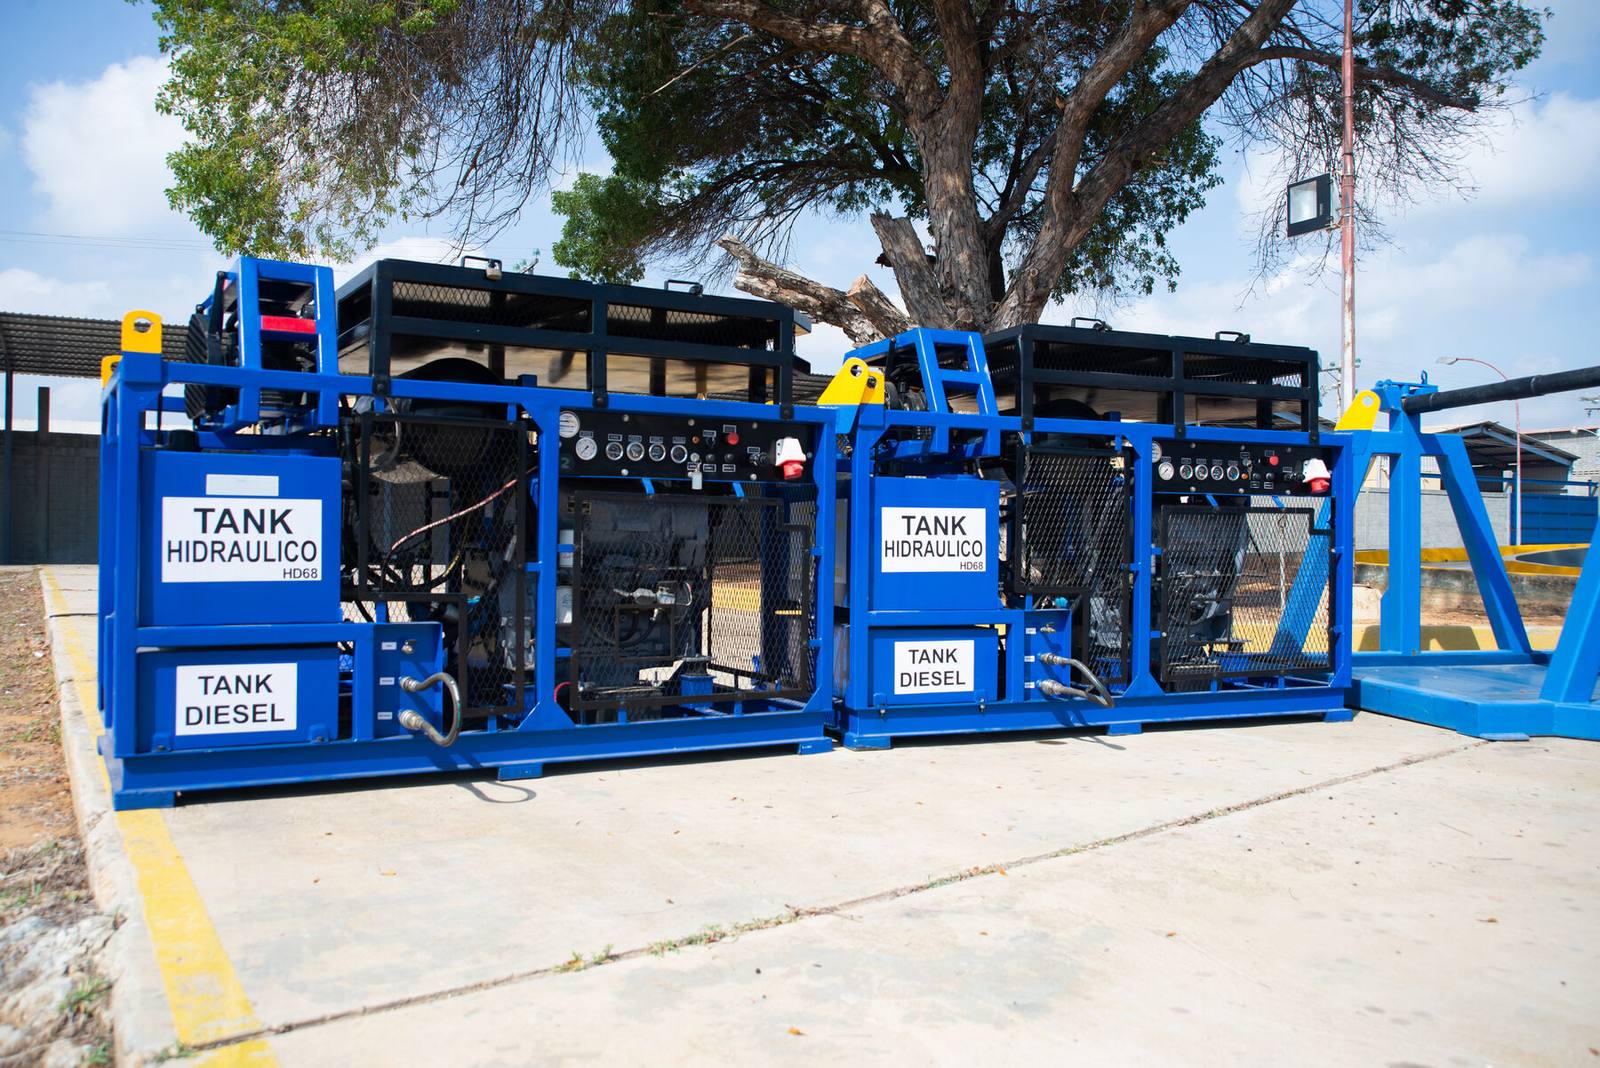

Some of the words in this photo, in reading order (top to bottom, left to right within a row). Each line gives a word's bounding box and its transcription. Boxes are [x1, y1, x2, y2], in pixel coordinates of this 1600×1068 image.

[193, 507, 293, 535] TANK
[901, 515, 967, 536] TANK
[167, 540, 317, 563] HIDRAULICO
[884, 539, 983, 558] HIDRAULICO
[283, 567, 318, 579] HD68
[960, 561, 984, 570] HD68
[908, 648, 958, 665] TANK
[197, 674, 273, 696] TANK
[900, 670, 966, 688] DIESEL
[185, 703, 285, 726] DIESEL
